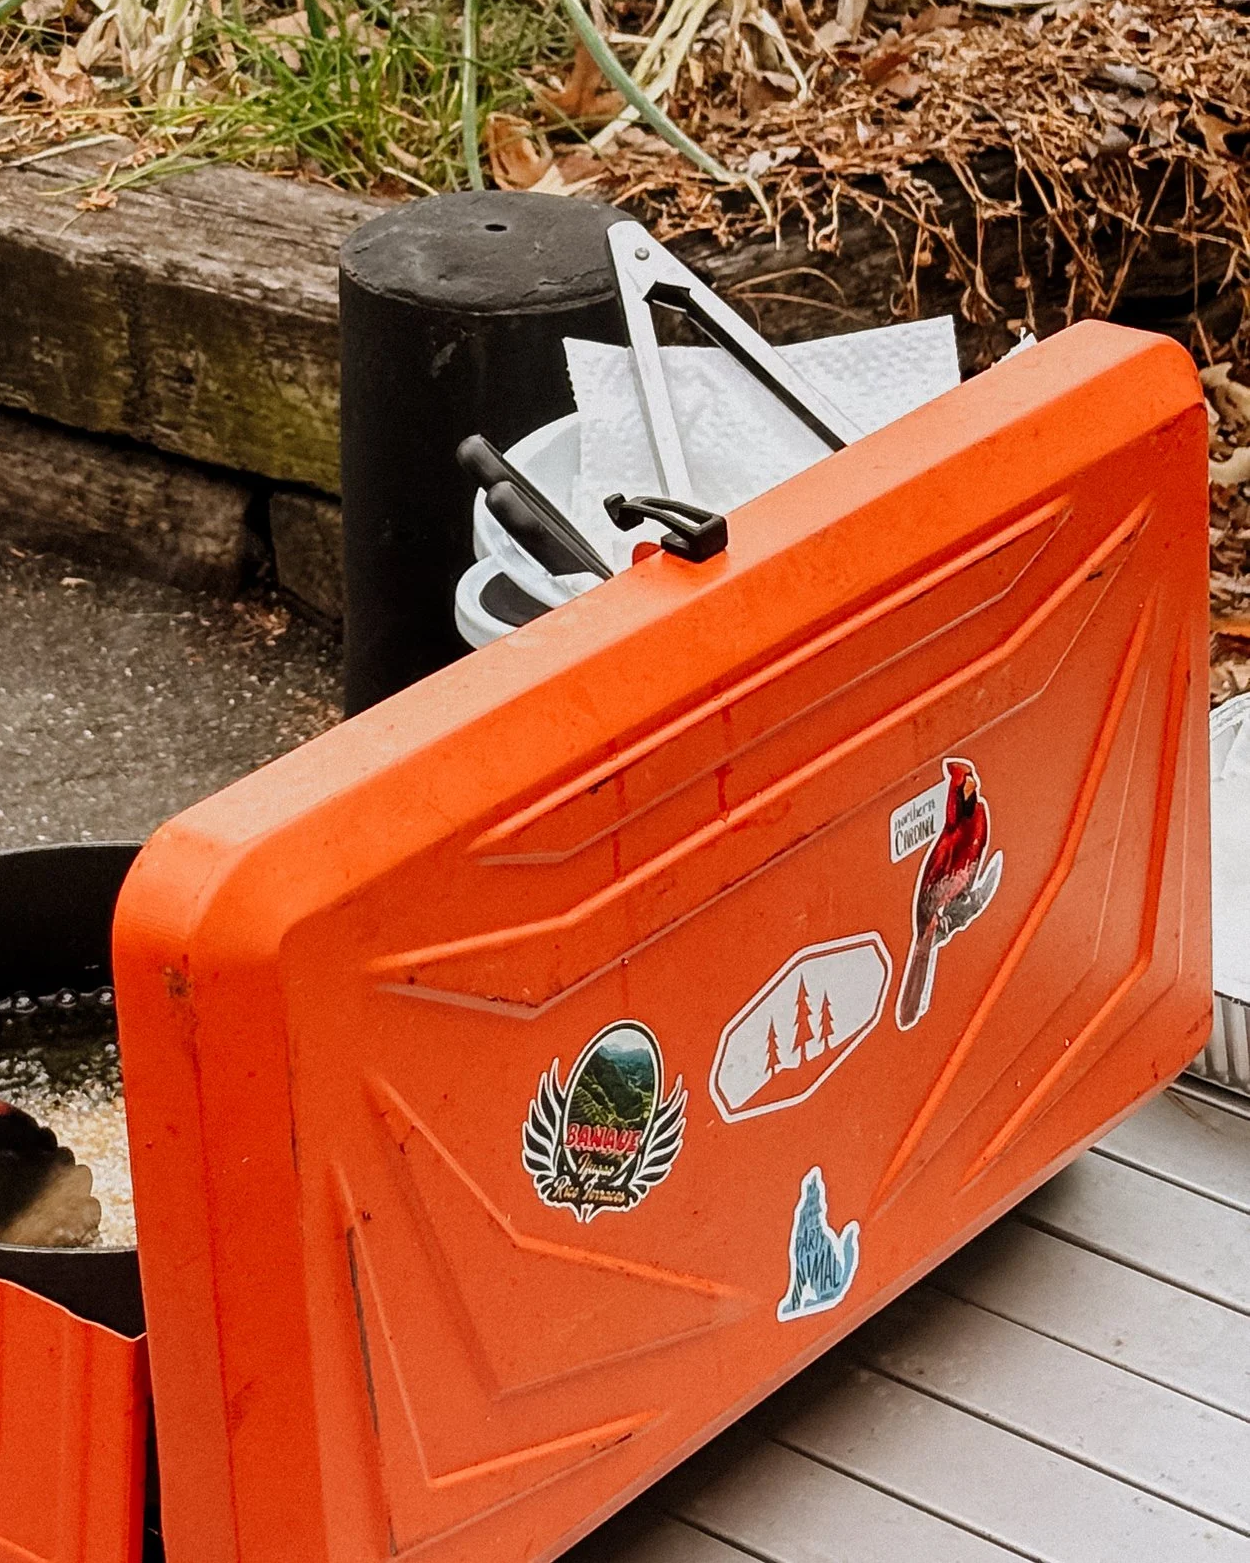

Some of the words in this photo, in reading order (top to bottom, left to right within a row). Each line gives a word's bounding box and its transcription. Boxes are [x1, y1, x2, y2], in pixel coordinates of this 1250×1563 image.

[564, 1123, 643, 1155] BANAUE
[796, 1226, 825, 1256] PARTY
[791, 1244, 840, 1311] ANIMAL
